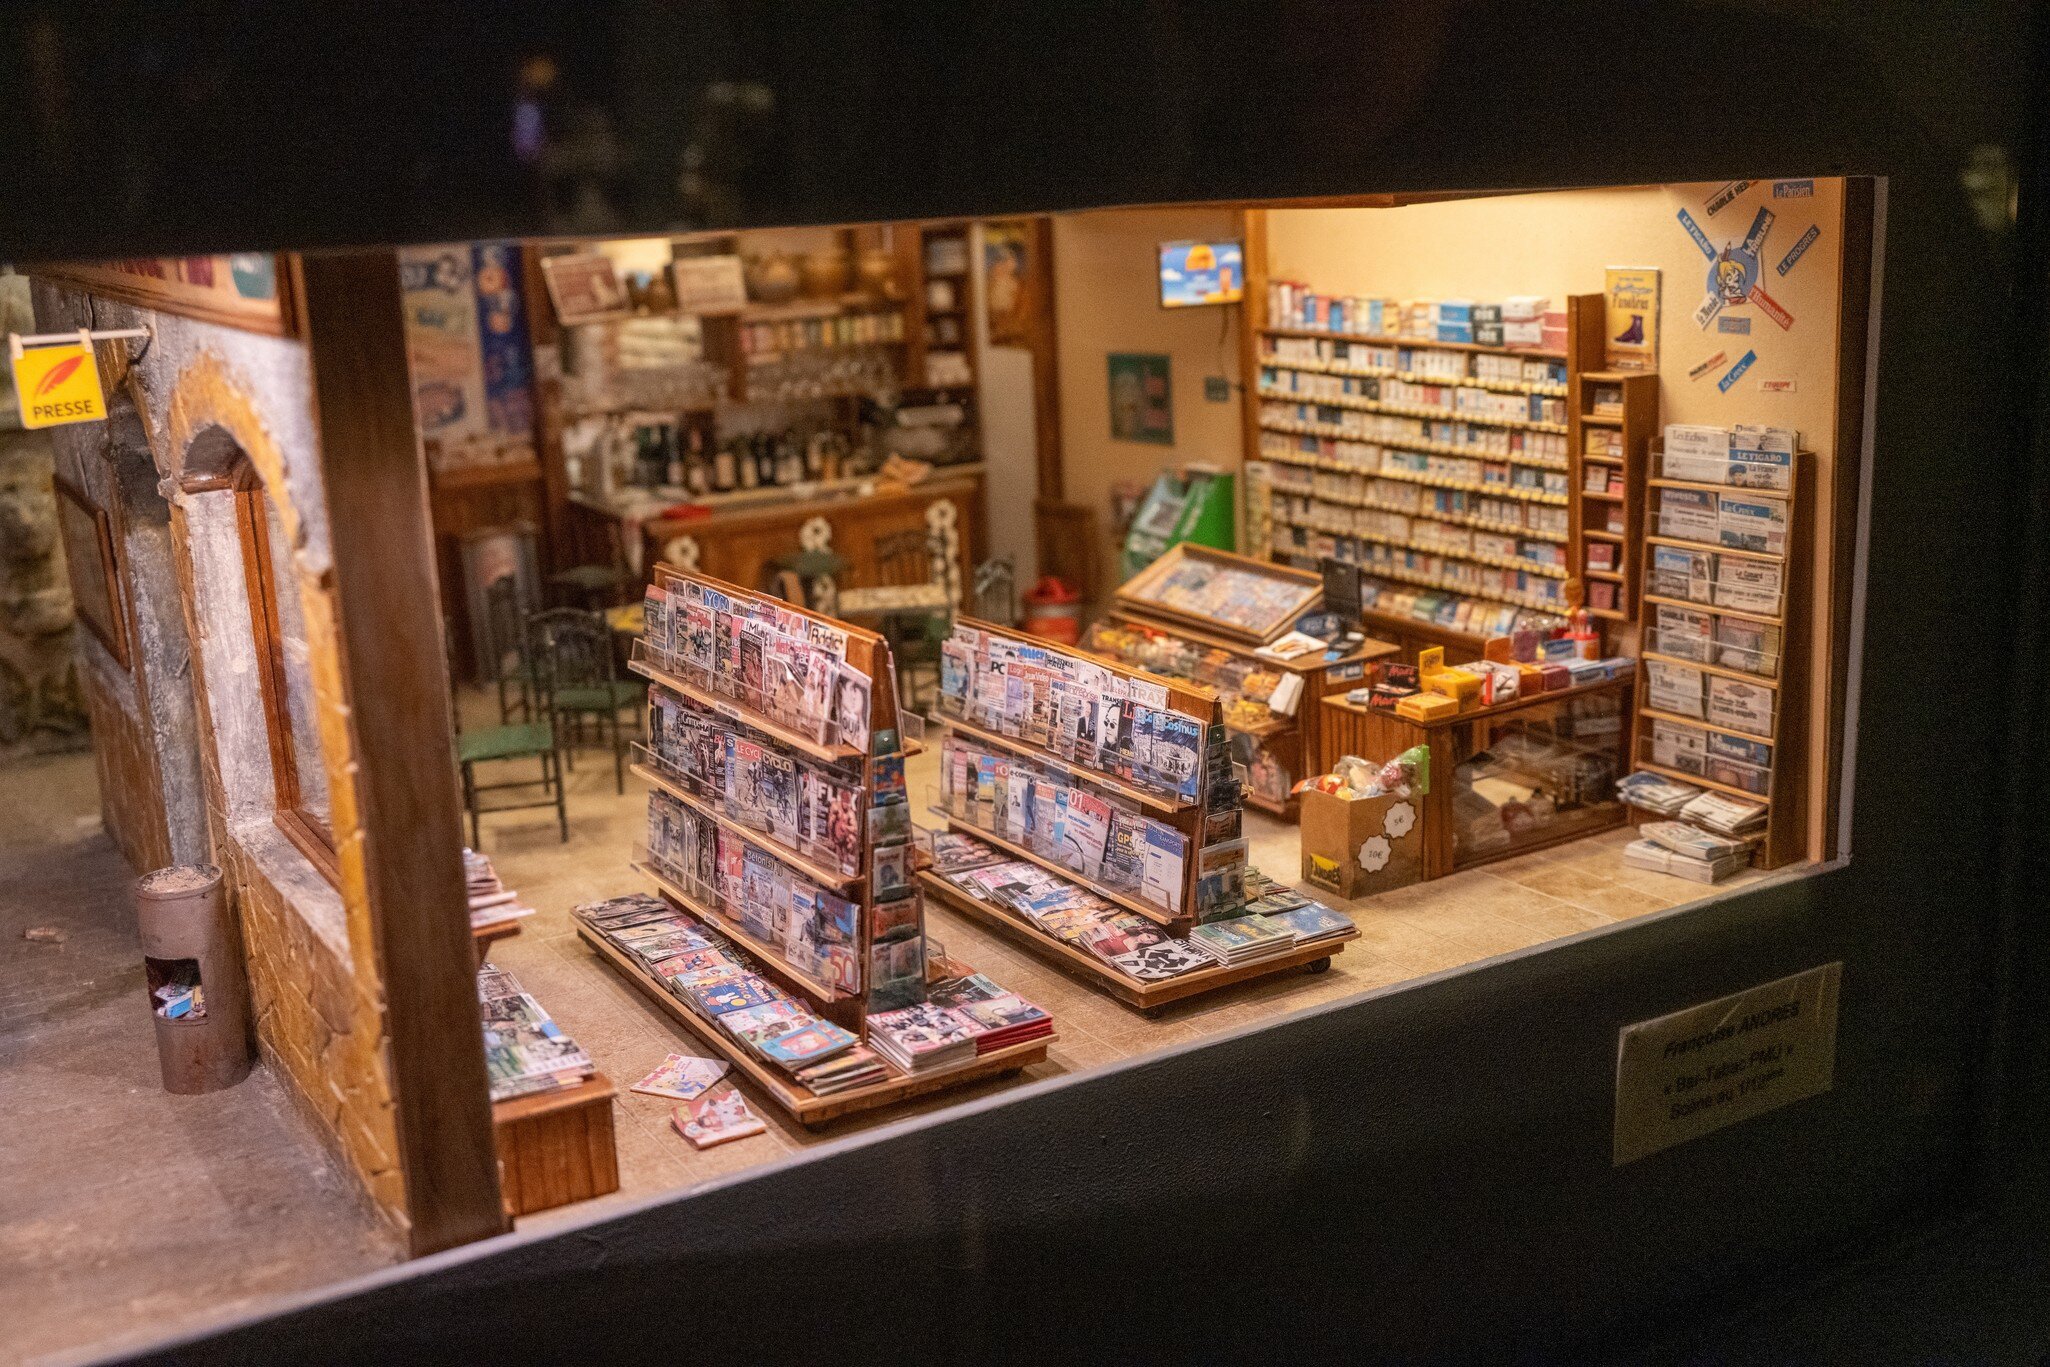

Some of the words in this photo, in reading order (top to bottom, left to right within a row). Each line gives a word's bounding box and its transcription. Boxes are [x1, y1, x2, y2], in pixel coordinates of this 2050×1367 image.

[33, 399, 95, 420] PRESSE
[1737, 451, 1748, 460] LE
[1749, 453, 1783, 463] FIGARO
[990, 661, 1005, 675] PC
[1131, 686, 1164, 707] TRAX
[736, 743, 745, 754] LE
[762, 753, 792, 773] CYCLO
[1069, 790, 1084, 809] 01
[829, 948, 855, 987] 50
